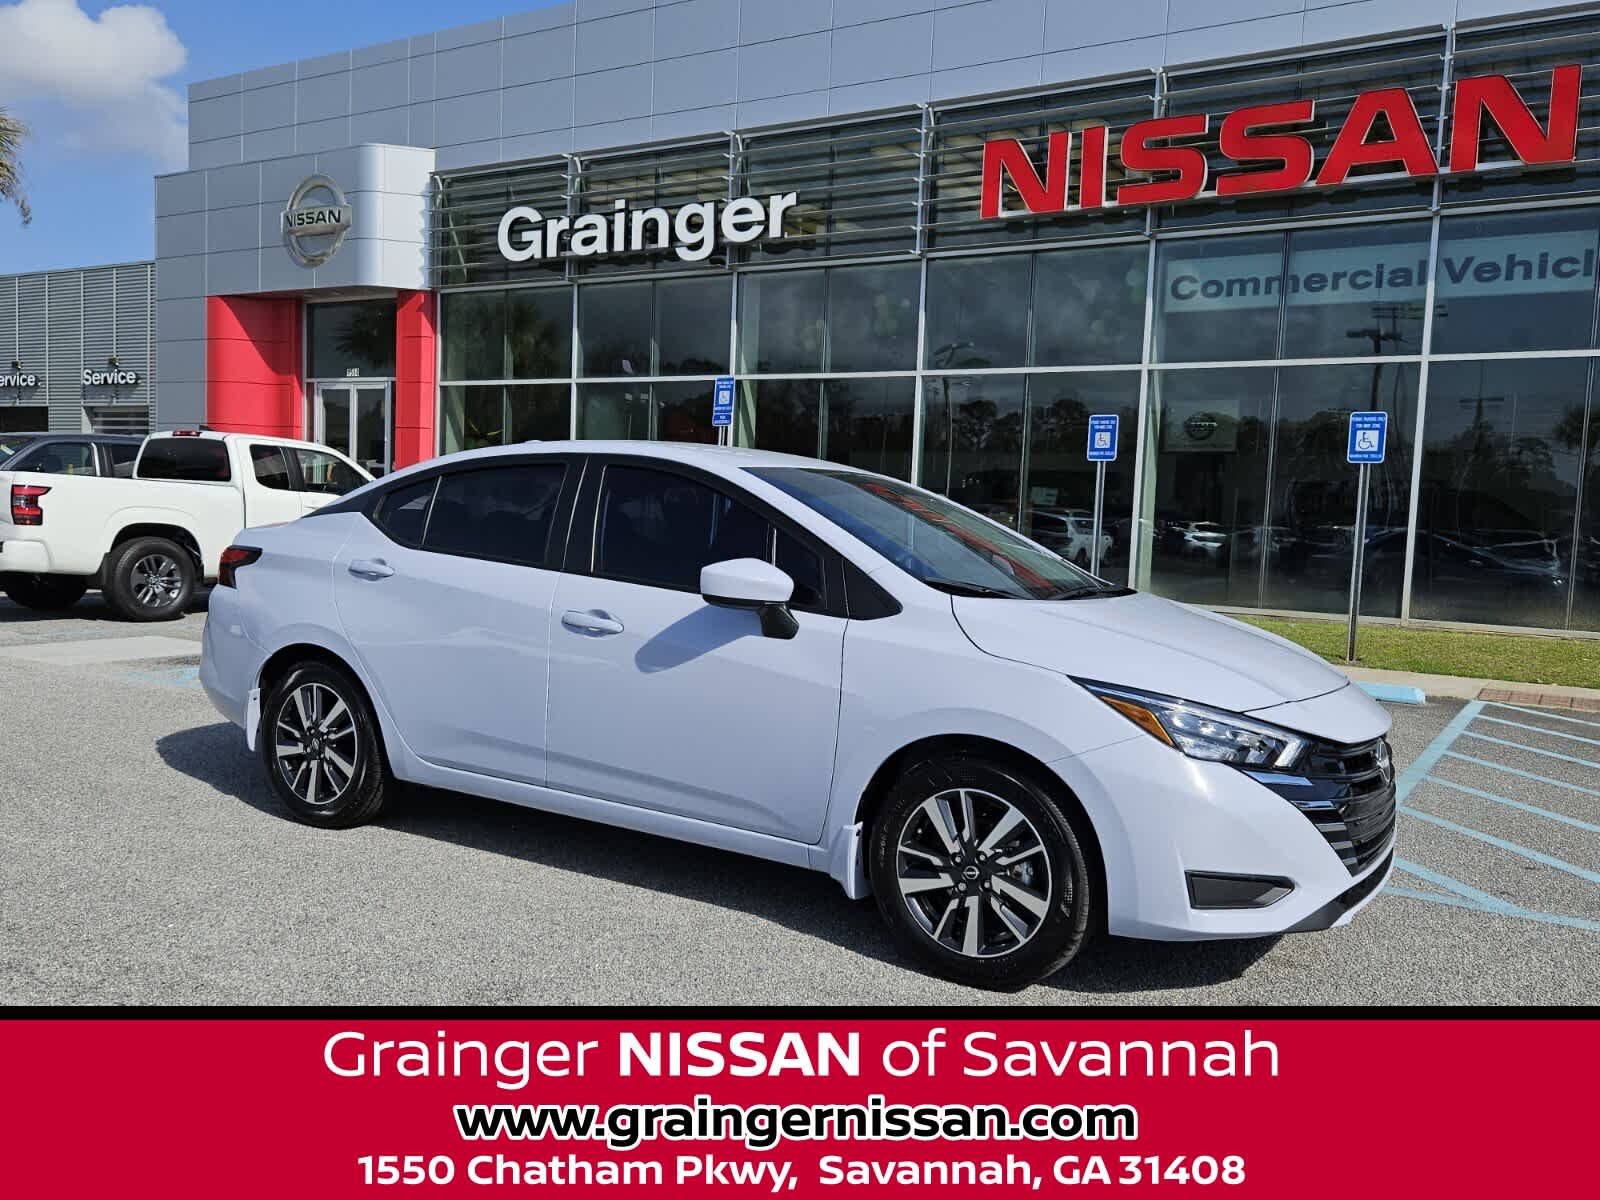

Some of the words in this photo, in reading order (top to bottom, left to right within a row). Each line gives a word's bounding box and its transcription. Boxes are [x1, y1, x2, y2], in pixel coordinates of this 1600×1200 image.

[980, 64, 1582, 219] NISSAN
[286, 209, 341, 228] NISSAN
[498, 191, 797, 263] Grainger
[1170, 259, 1428, 301] Commercial
[83, 368, 137, 385] Service
